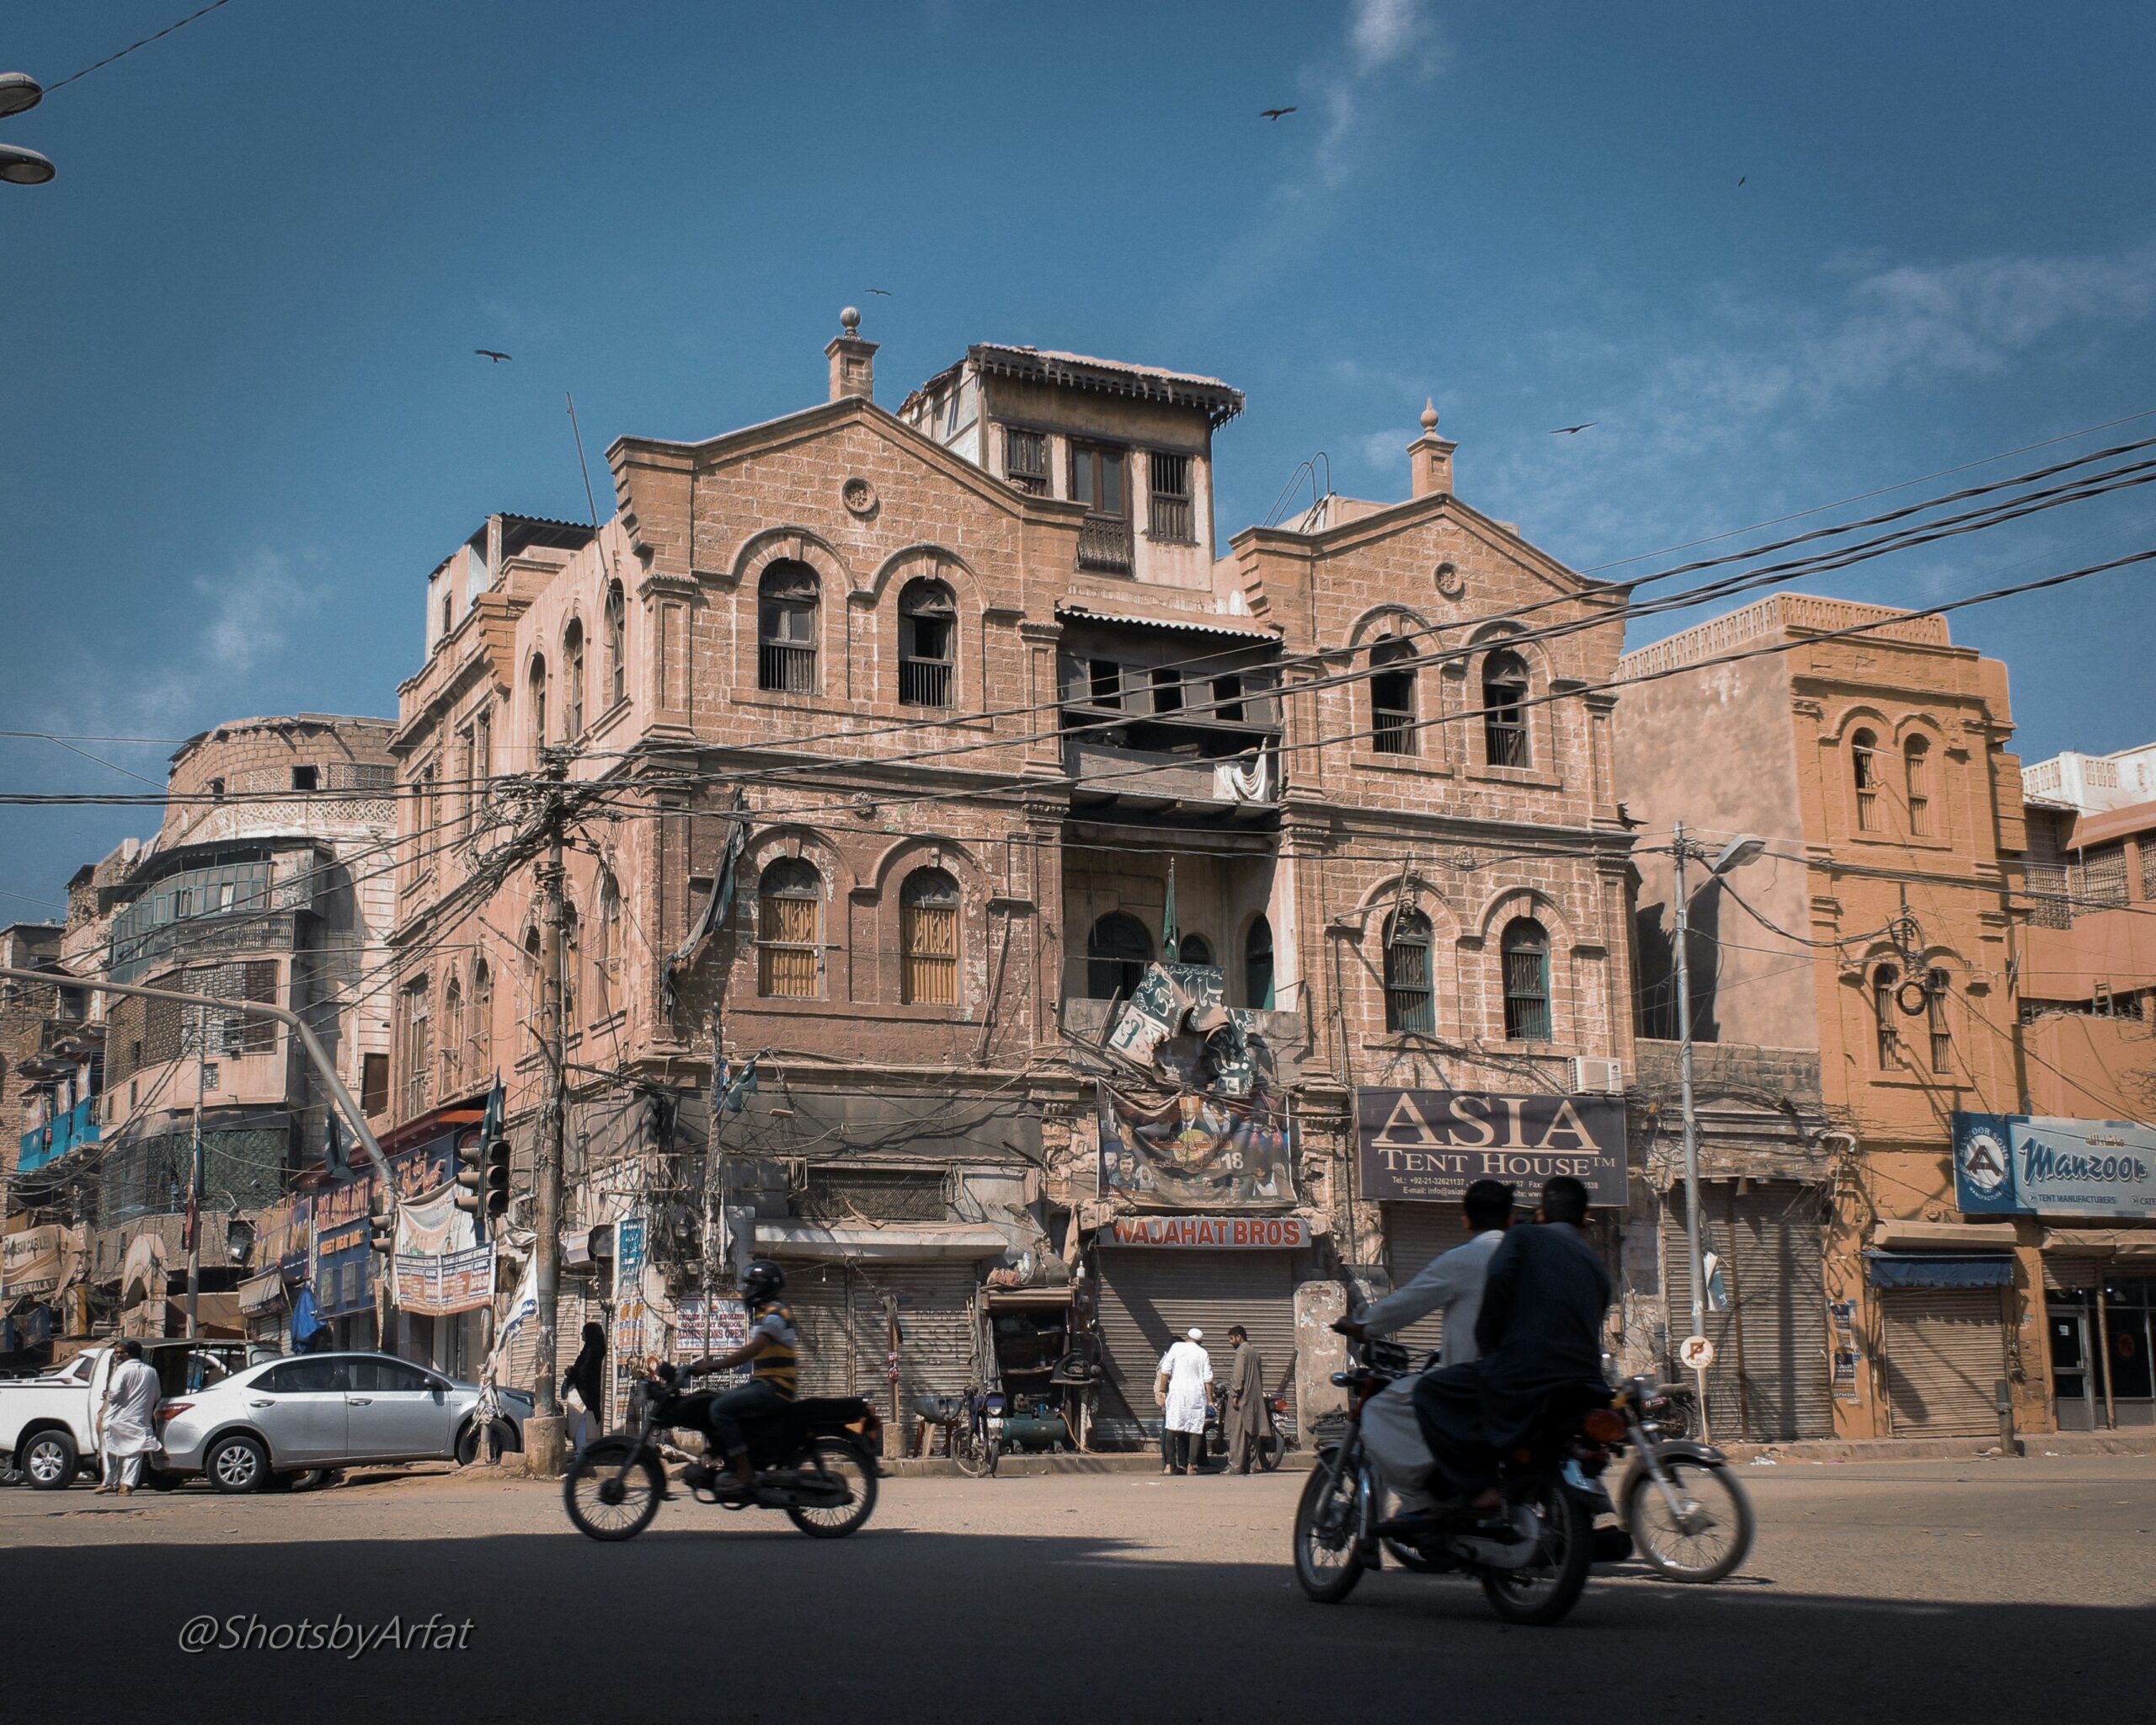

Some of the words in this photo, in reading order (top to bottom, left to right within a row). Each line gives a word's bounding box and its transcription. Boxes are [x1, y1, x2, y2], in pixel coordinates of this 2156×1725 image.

[1371, 1092, 1602, 1151] ASIA
[1221, 1152, 1244, 1170] 18
[1379, 1149, 1468, 1172] TENT
[1481, 1153, 1590, 1177] HOUSE
[2019, 1137, 2148, 1185] Manzoor
[2056, 1194, 2116, 1204] MANUFACTURERS
[1111, 1220, 1229, 1245] WAJAHAT
[1234, 1220, 1302, 1246] BROS
[677, 1329, 723, 1339] ADMISSONS
[724, 1329, 744, 1338] OPEN
